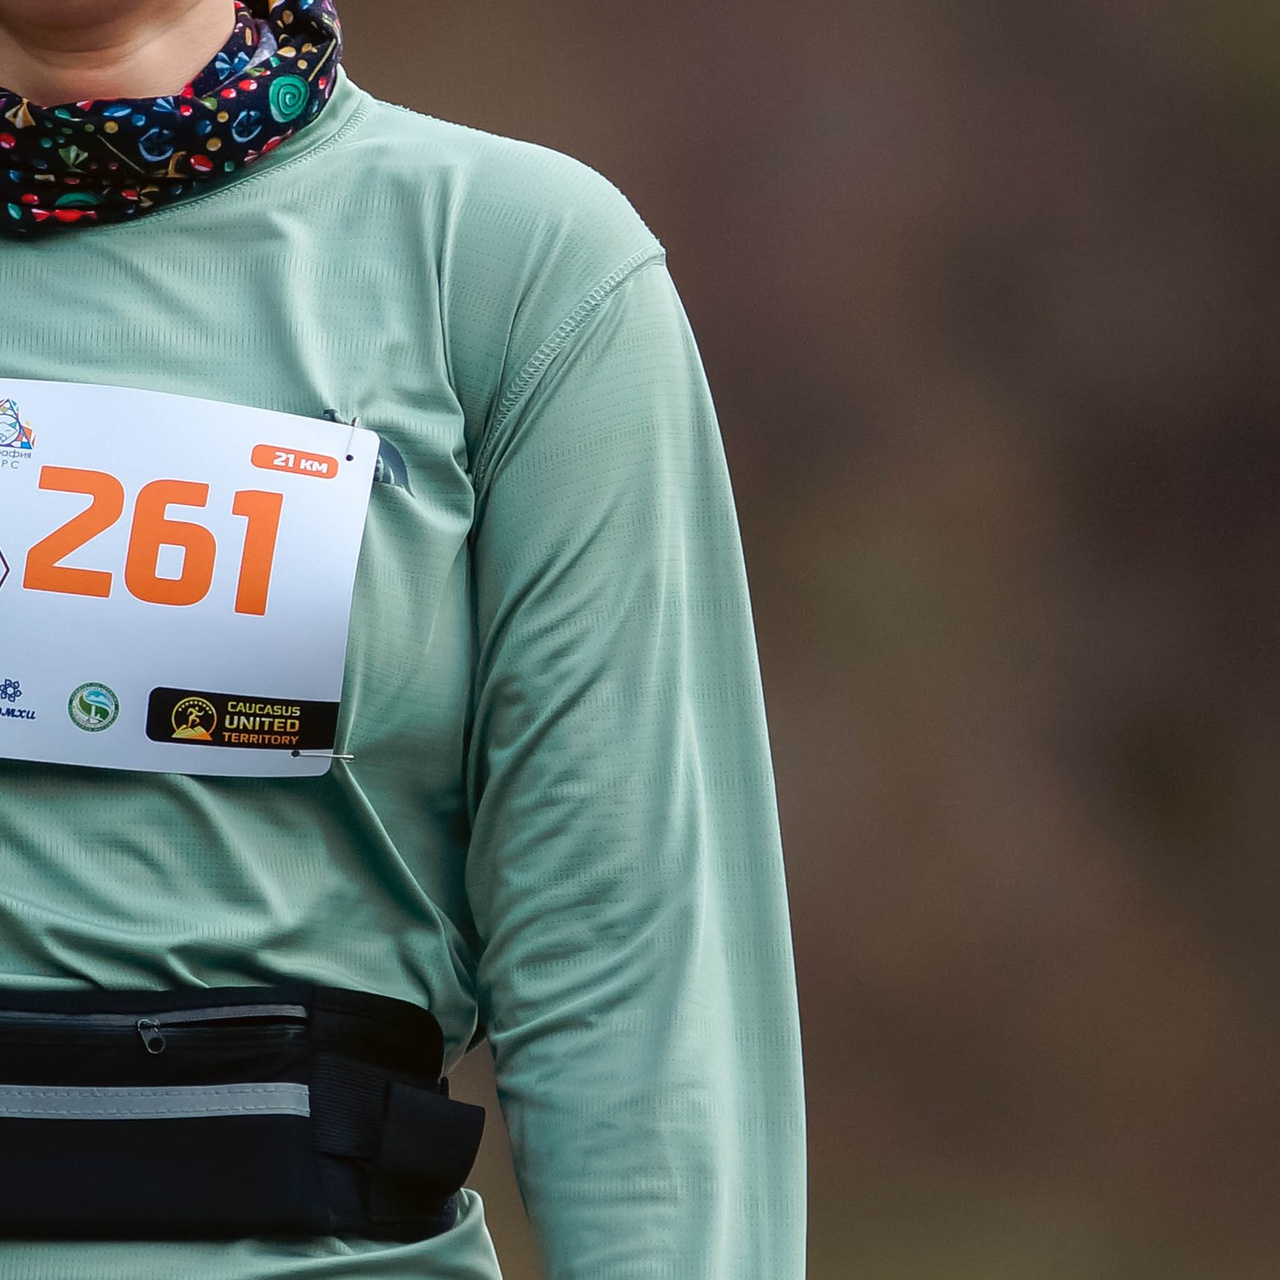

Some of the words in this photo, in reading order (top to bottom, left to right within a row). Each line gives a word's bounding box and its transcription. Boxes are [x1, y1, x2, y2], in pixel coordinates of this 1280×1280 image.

[273, 451, 295, 468] 21
[23, 465, 284, 616] 261
[227, 701, 301, 717] CAUCASUS
[225, 715, 300, 733] UNITED
[222, 731, 300, 745] TERRITORY
